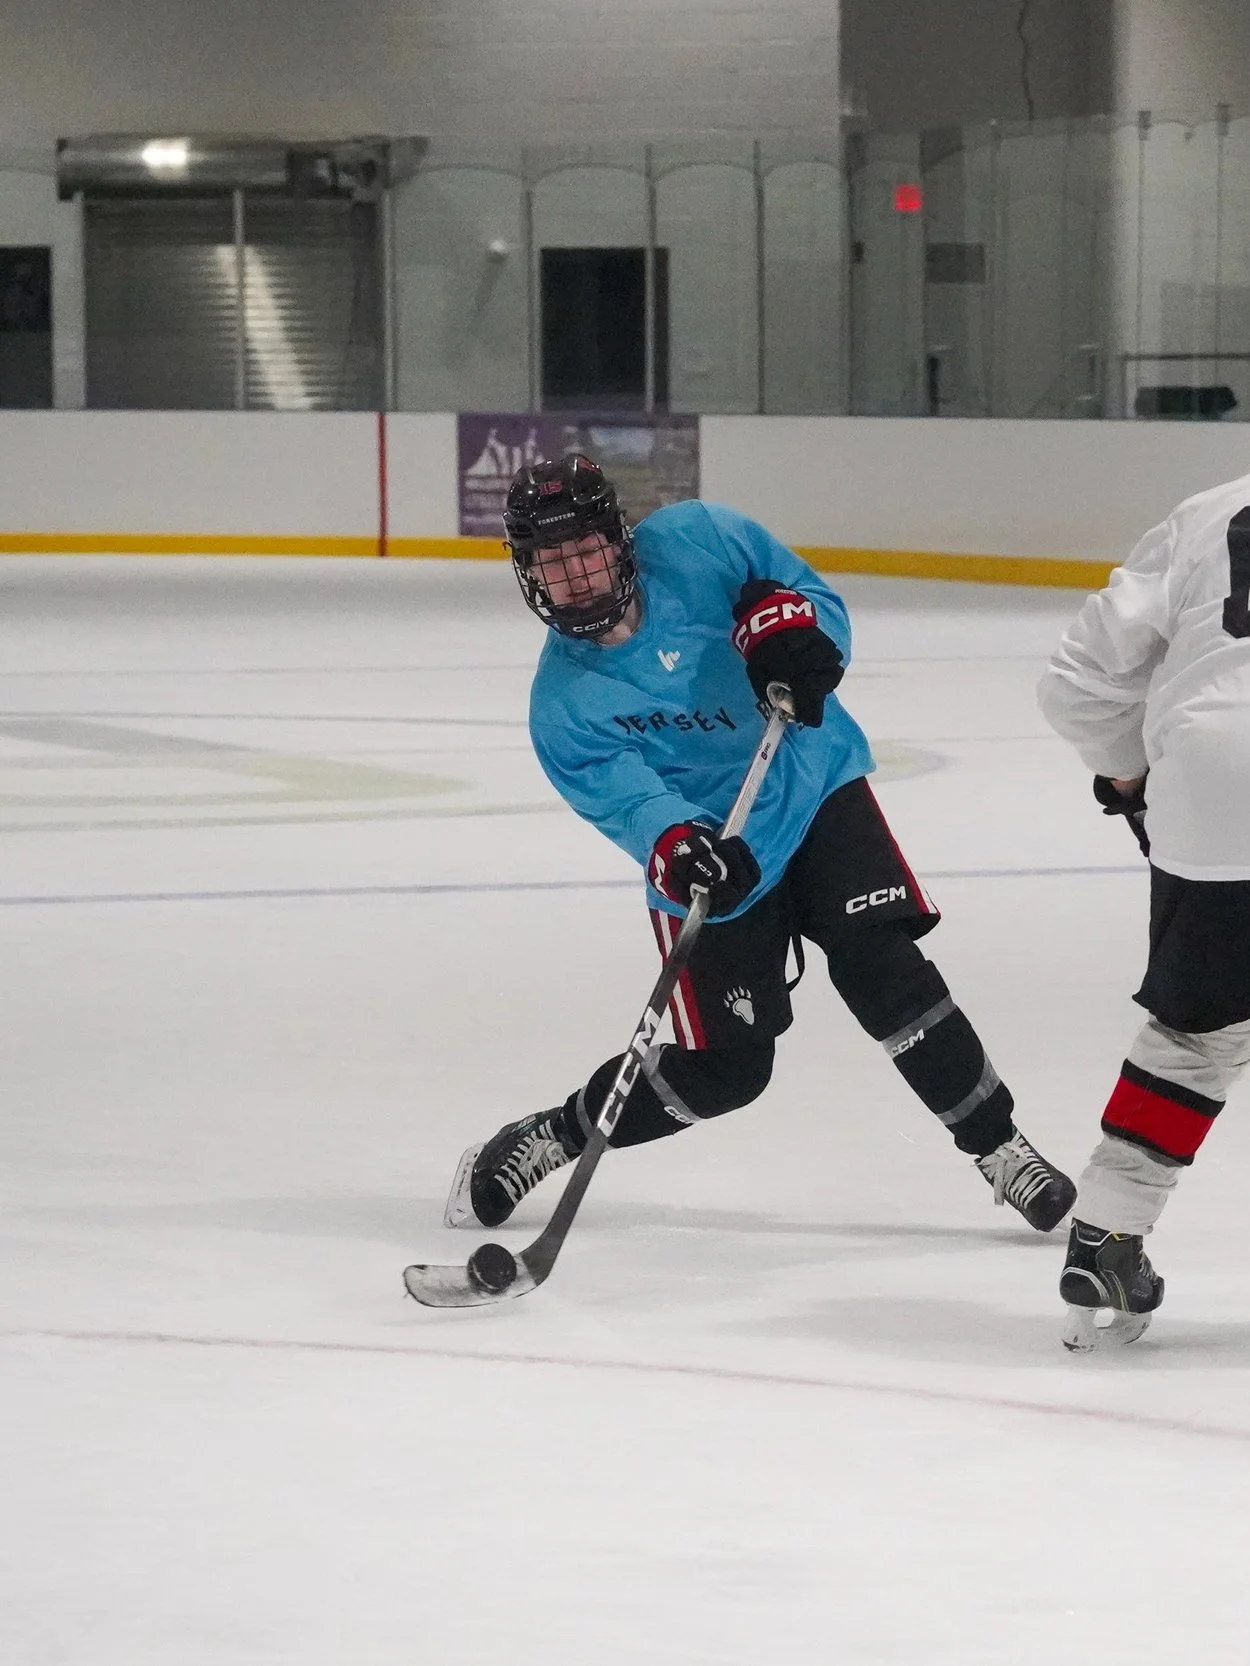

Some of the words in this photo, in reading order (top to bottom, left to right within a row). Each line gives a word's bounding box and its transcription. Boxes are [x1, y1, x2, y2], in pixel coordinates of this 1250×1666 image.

[572, 616, 610, 633] CCM
[735, 600, 813, 654] CCM
[612, 706, 737, 736] JERSEY
[845, 885, 907, 915] CCM
[596, 1006, 661, 1138] CCM
